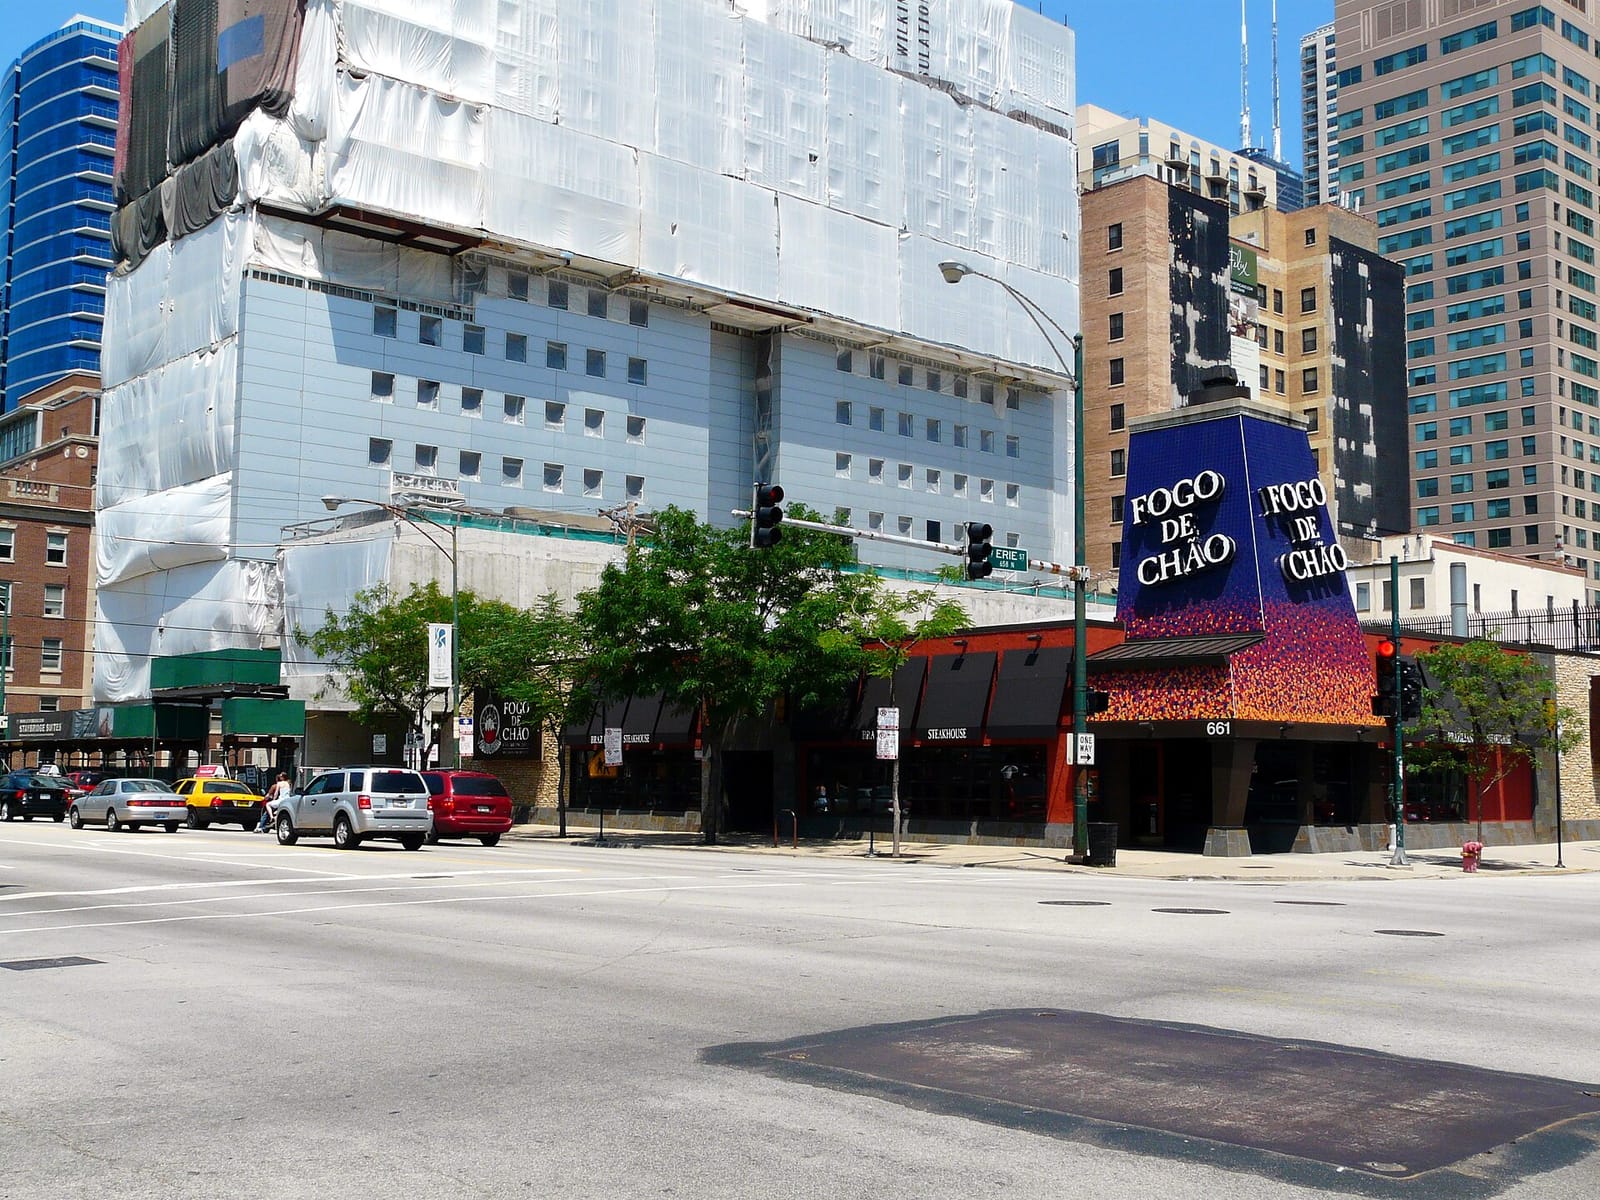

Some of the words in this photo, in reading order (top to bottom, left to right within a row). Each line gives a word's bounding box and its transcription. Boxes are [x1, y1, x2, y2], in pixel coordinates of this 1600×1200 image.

[1131, 470, 1222, 525] FOGO
[1264, 478, 1326, 514] FOGO
[1161, 513, 1194, 543] DE
[1294, 516, 1320, 542] DE
[995, 549, 1018, 560] ERIE
[1137, 533, 1233, 586] CHÃO
[1286, 541, 1347, 580] CHÃO
[503, 701, 530, 715] FOGO
[511, 715, 522, 727] DE
[927, 728, 967, 739] STEAKHOUSE
[1206, 722, 1231, 735] 661
[1079, 736, 1093, 744] ONE
[1079, 744, 1093, 752] WAY
